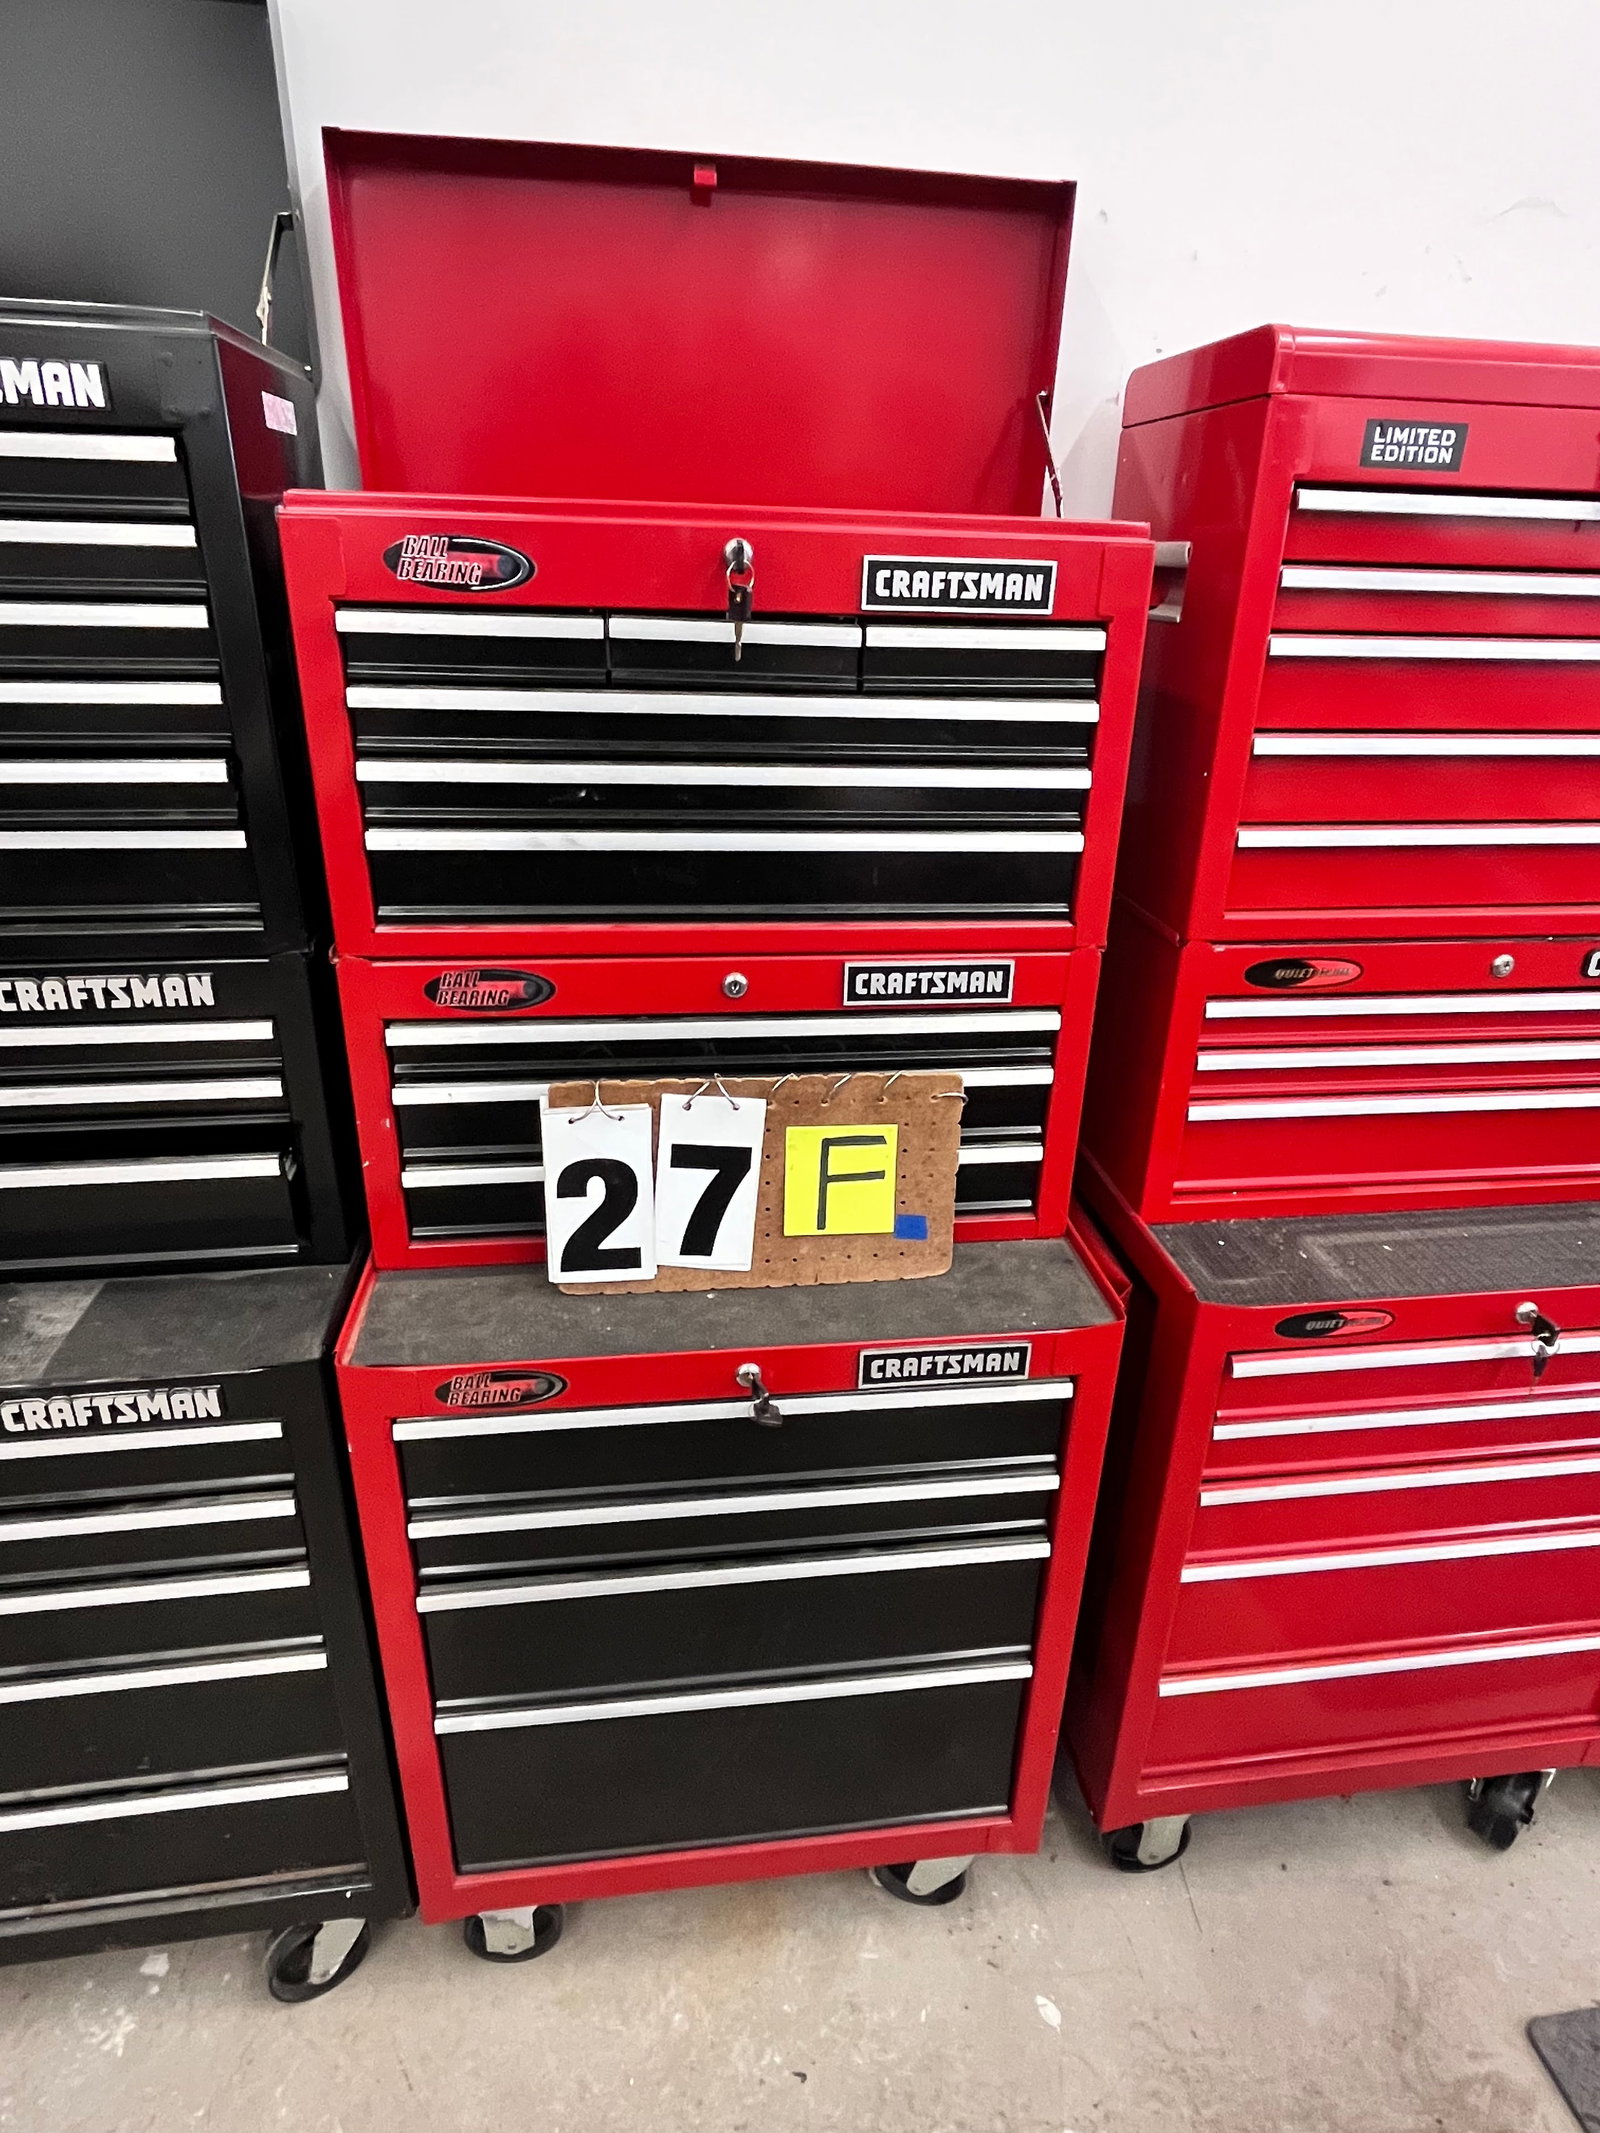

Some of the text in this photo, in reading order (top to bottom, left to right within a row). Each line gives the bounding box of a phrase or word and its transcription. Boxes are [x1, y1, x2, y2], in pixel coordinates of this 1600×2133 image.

[0, 359, 106, 408] MAN
[1373, 426, 1457, 447] LIMITED
[1370, 444, 1454, 464] EDITION
[401, 534, 449, 559] BALL
[397, 557, 483, 585] BEARING
[875, 569, 1045, 602] CRAFTSMAN
[440, 970, 481, 989] BALL
[855, 970, 1004, 995] CRAFTSMAN
[0, 975, 215, 1012] CRAFTSMAN
[436, 988, 510, 1007] BEARING
[816, 1135, 888, 1231] F
[870, 1351, 1020, 1379] CRAFTSMAN
[450, 1372, 492, 1392] BALL
[447, 1387, 522, 1407] BEARING
[0, 1388, 222, 1433] CRAFTSMAN
